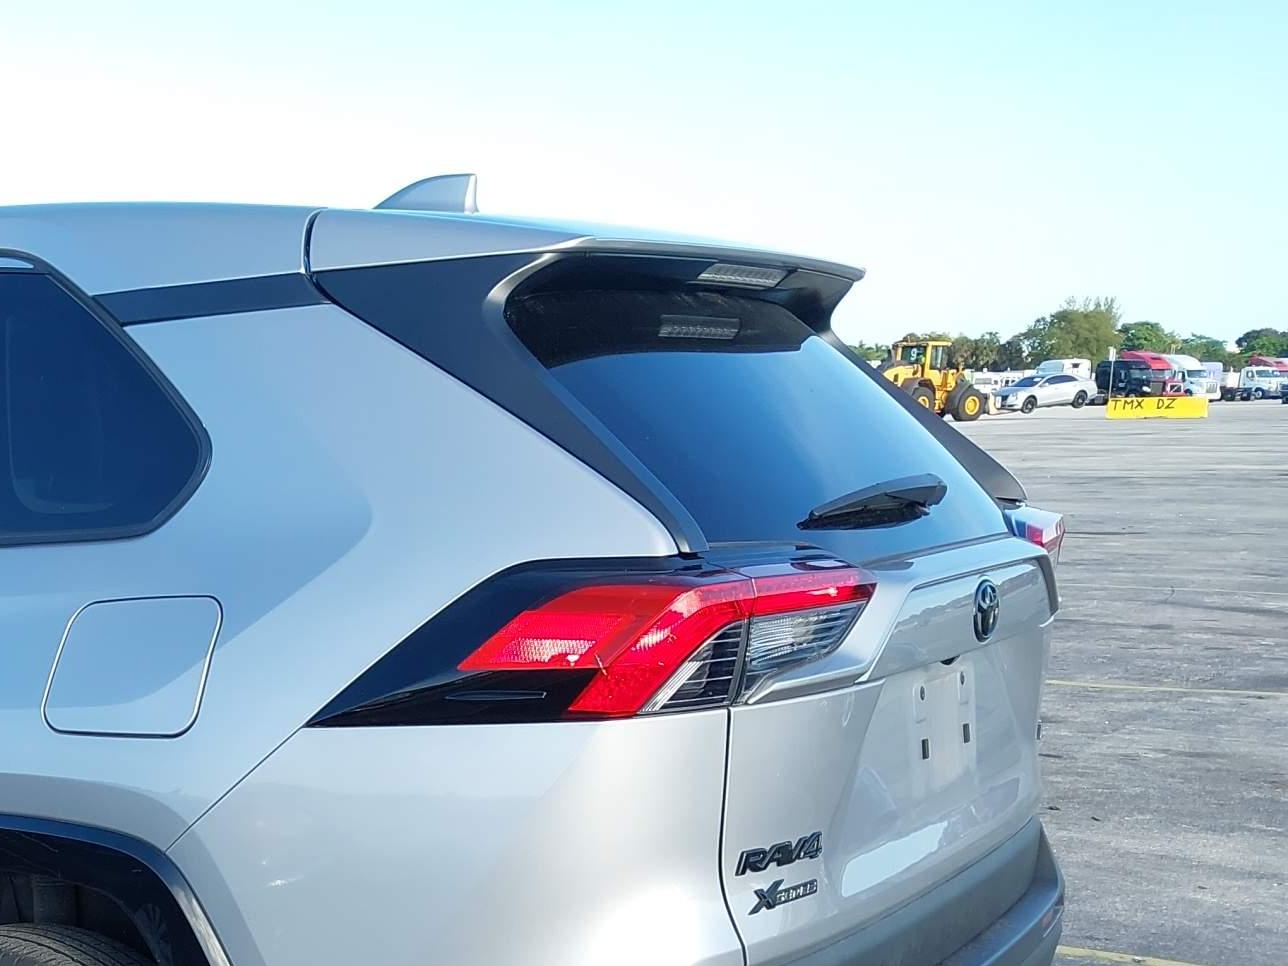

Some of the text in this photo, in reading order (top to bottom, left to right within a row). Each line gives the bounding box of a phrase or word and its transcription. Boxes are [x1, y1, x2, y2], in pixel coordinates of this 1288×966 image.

[1111, 398, 1178, 411] TMX DZ
[734, 831, 823, 877] RAV4
